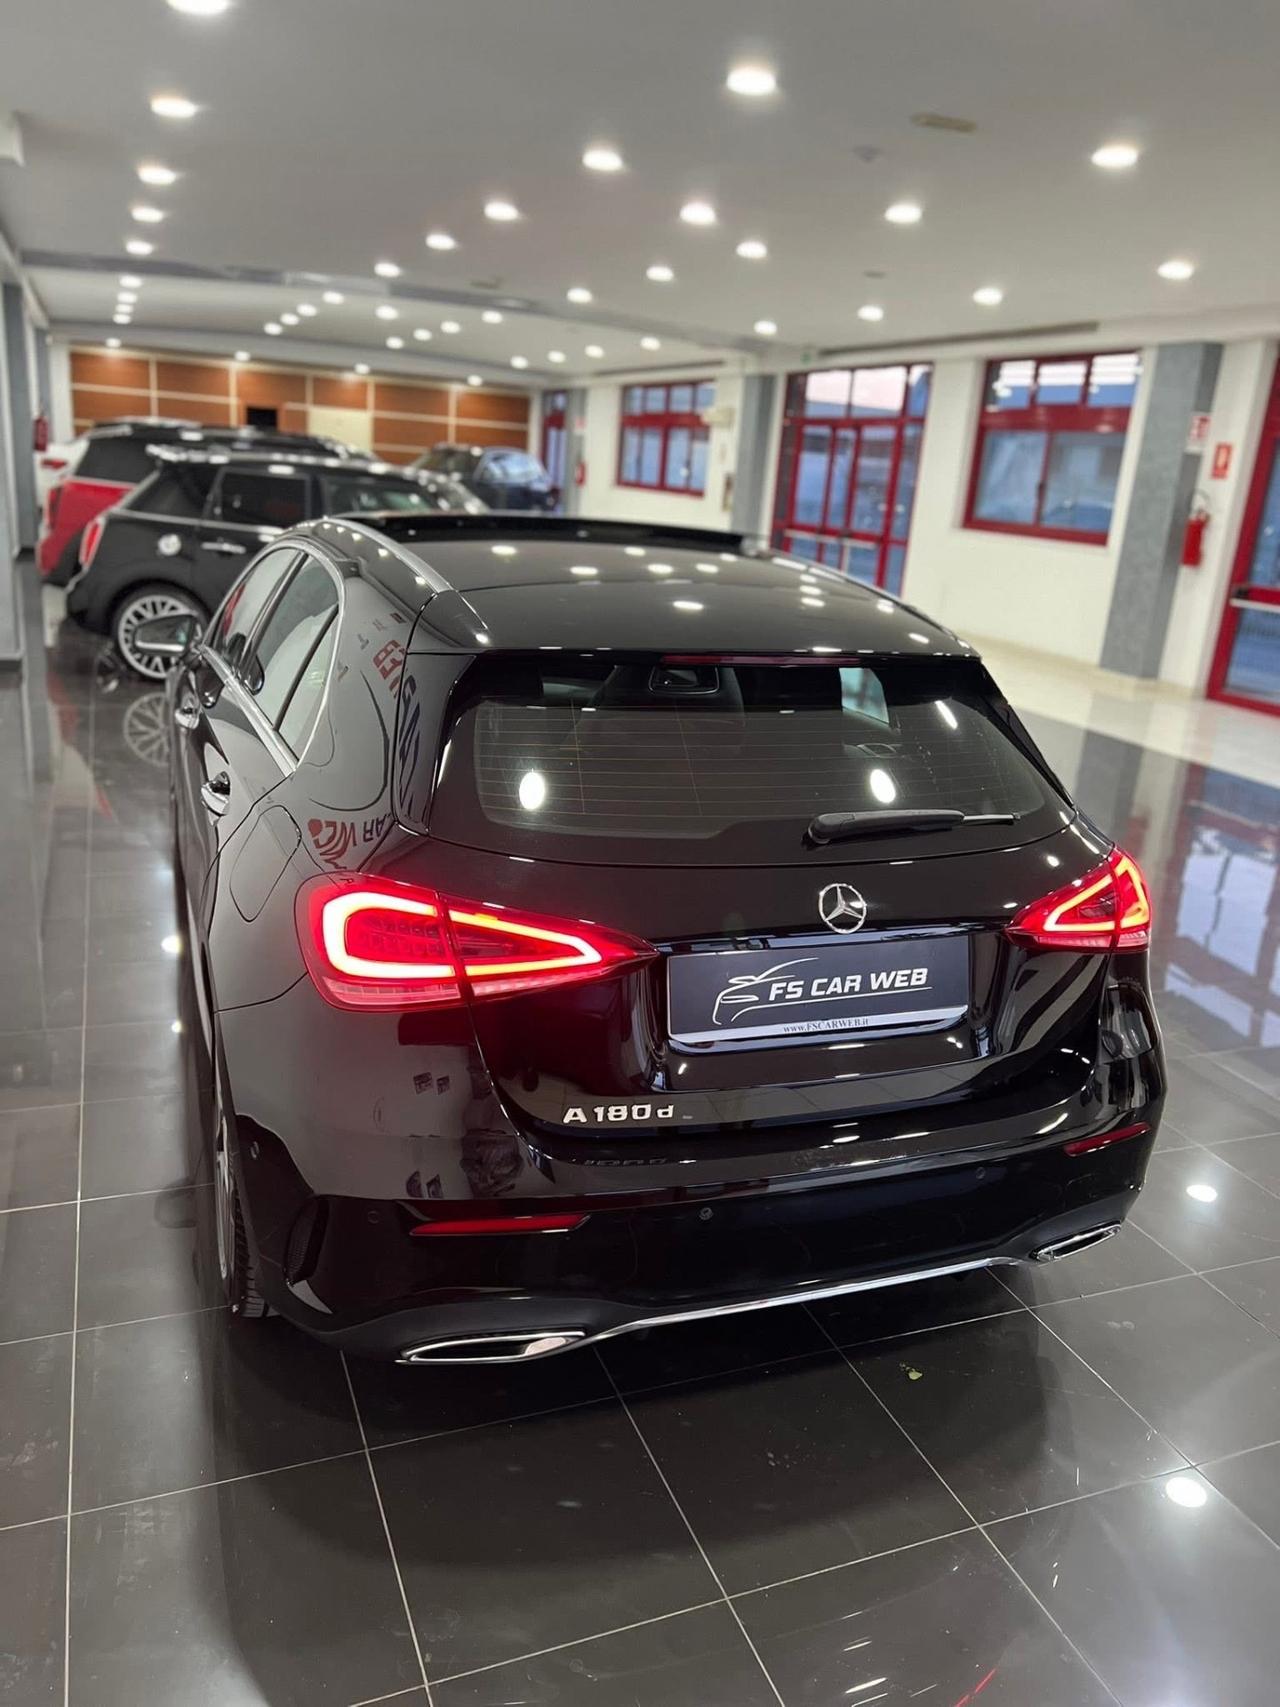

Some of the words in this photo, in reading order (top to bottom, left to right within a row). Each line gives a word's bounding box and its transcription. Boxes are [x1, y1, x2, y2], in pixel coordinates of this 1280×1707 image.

[768, 980, 804, 1001] FS
[810, 974, 862, 997] CAR
[870, 967, 928, 991] WEB
[563, 1107, 588, 1124] A
[593, 1103, 652, 1122] 180
[656, 1104, 675, 1119] d
